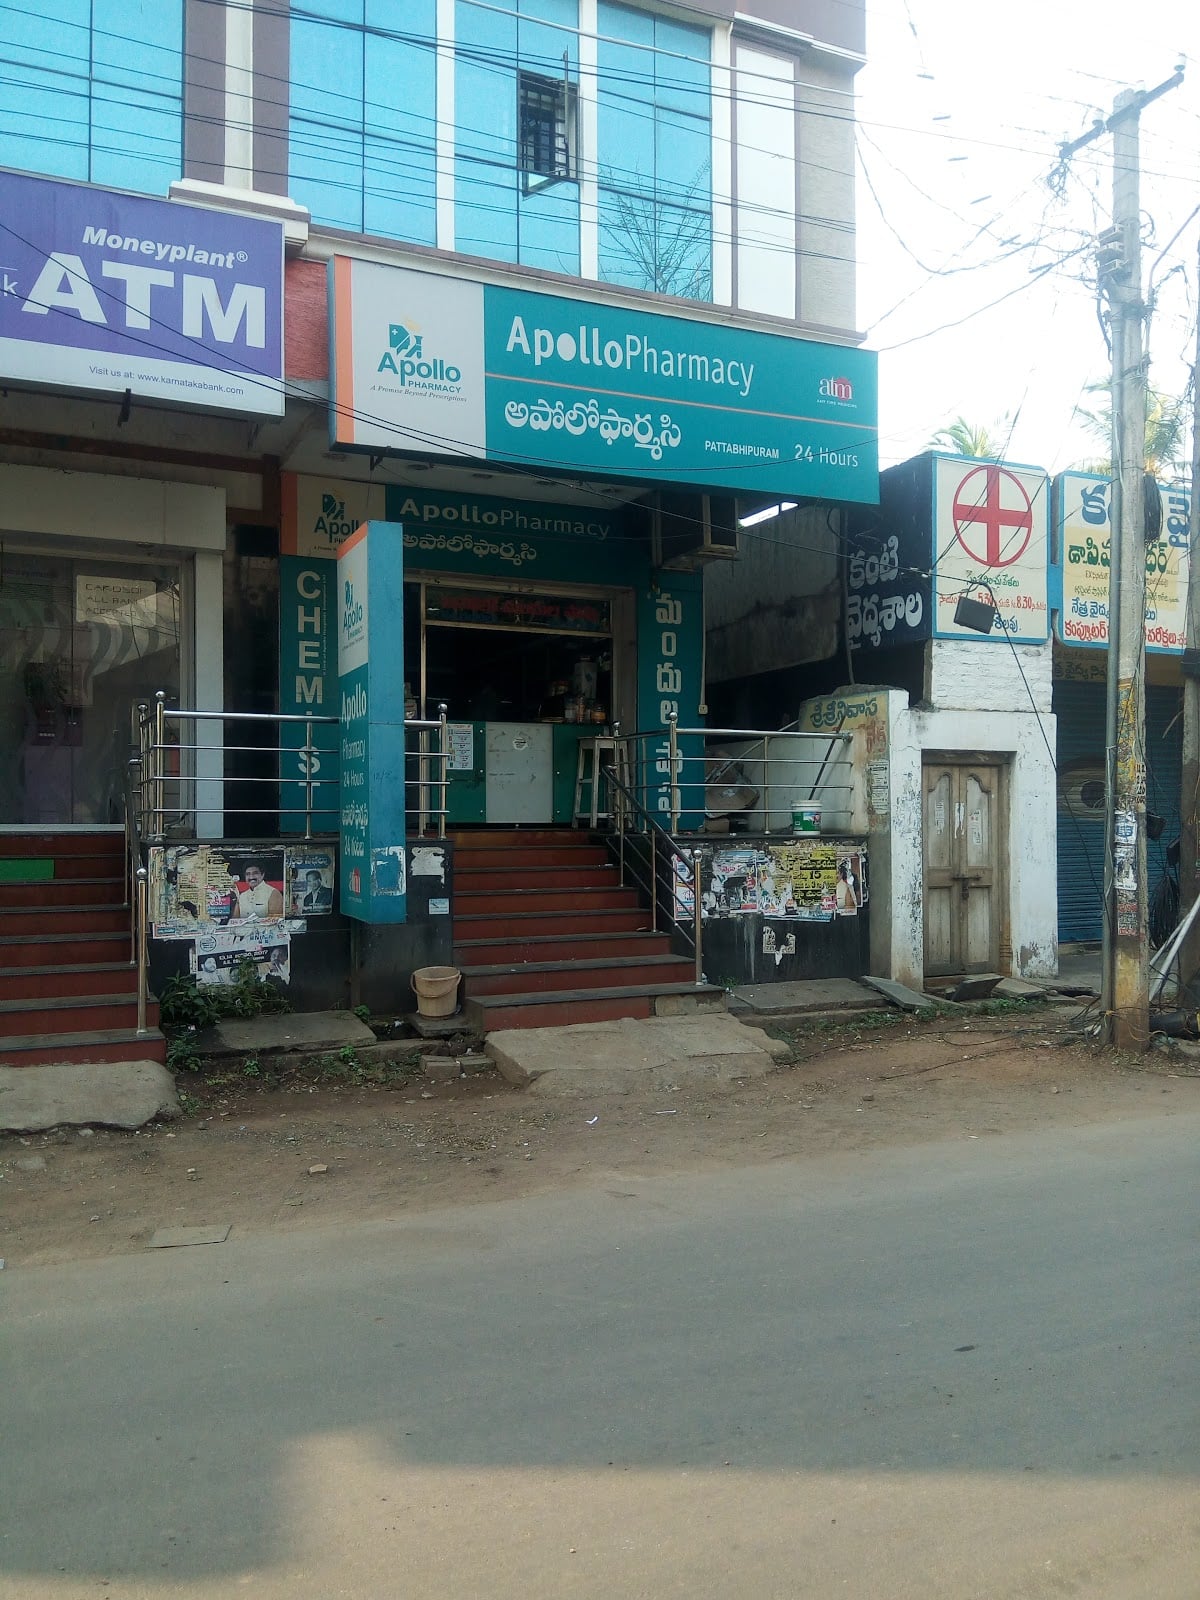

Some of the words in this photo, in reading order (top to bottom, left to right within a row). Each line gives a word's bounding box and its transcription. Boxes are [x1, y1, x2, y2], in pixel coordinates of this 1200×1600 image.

[21, 251, 266, 349] ATM
[89, 365, 109, 376] Visit
[110, 369, 122, 378] us
[123, 371, 135, 380] at:
[377, 351, 461, 387] Apollo
[408, 380, 462, 394] PHARMACY
[819, 376, 853, 400] atm
[705, 440, 780, 459] PATTABHIPURAM
[794, 444, 814, 463] 24
[818, 447, 859, 468] Hours
[314, 517, 360, 544] Apoll
[343, 602, 363, 640] Apollo
[295, 570, 323, 809] CHEMST
[341, 683, 366, 730] Apollo
[342, 738, 366, 763] Pharmacy
[343, 771, 350, 788] 24
[351, 769, 365, 787] Hours
